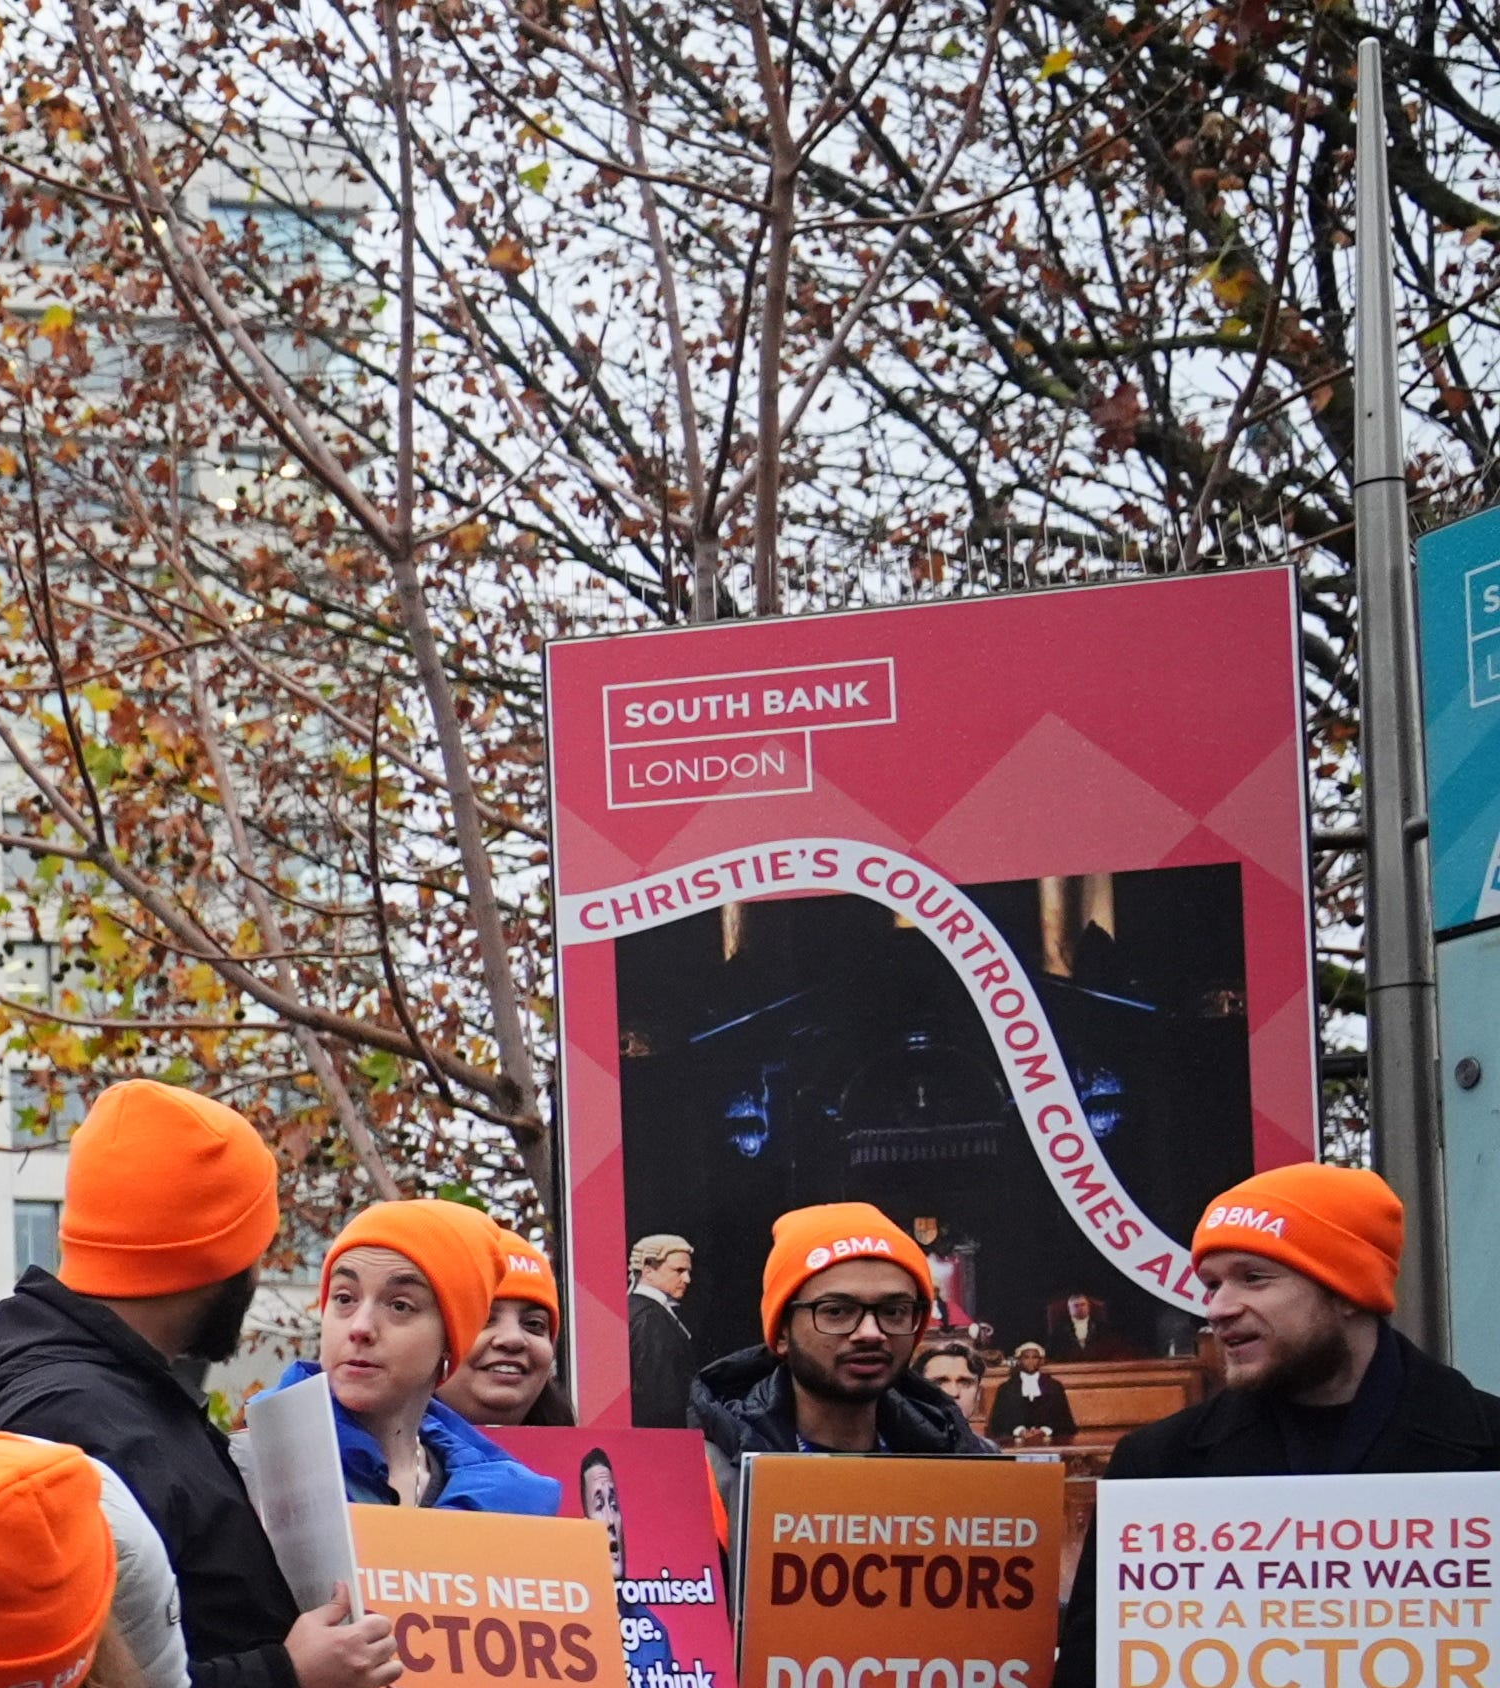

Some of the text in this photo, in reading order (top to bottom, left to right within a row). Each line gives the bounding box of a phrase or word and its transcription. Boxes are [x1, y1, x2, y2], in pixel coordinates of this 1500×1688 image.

[624, 681, 870, 728] SOUTH BANK
[629, 750, 785, 788] LONDON
[579, 848, 839, 931] CHRISTIE'S
[856, 856, 1058, 1093] COURTROOM
[1037, 1103, 1143, 1252] COMES
[1224, 1206, 1285, 1238] BMA
[508, 1253, 541, 1275] MA
[832, 1236, 891, 1257] BMA
[773, 1515, 1037, 1548] PATIENTS NEED
[1119, 1517, 1492, 1553] £18.62/HOUR IS
[771, 1553, 1035, 1611] DOCTORS
[1119, 1559, 1492, 1590] NOT A FAIR WAGE
[488, 1578, 590, 1614] NEED
[1118, 1598, 1492, 1629] FOR A RESIDENT
[390, 1615, 598, 1684] CTORS
